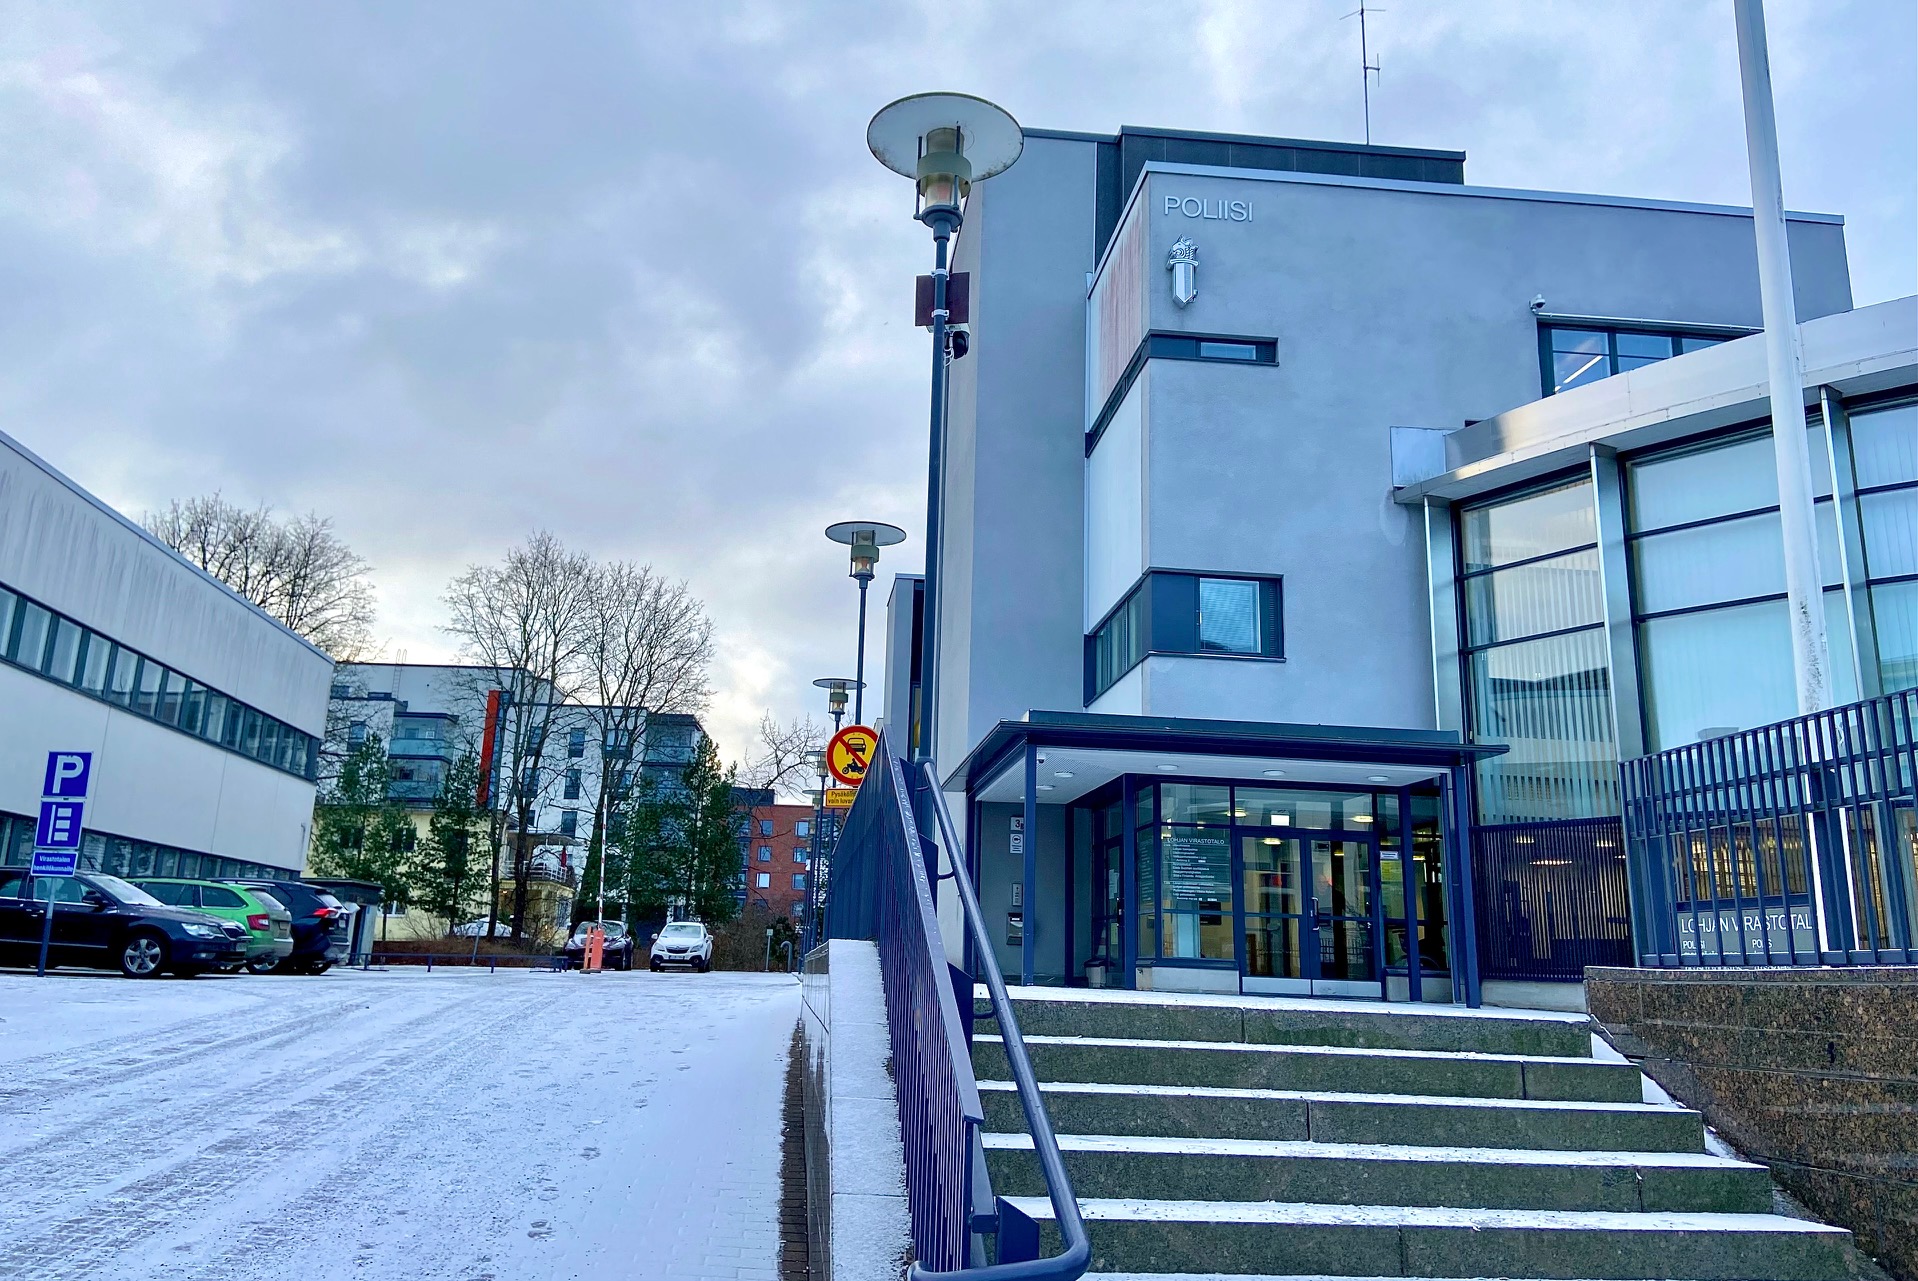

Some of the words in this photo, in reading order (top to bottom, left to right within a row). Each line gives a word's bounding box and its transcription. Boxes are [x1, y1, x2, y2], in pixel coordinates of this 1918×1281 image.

[1164, 195, 1253, 222] POLIISI
[52, 754, 84, 794] P
[1731, 914, 1813, 932] VRASTOTAL
